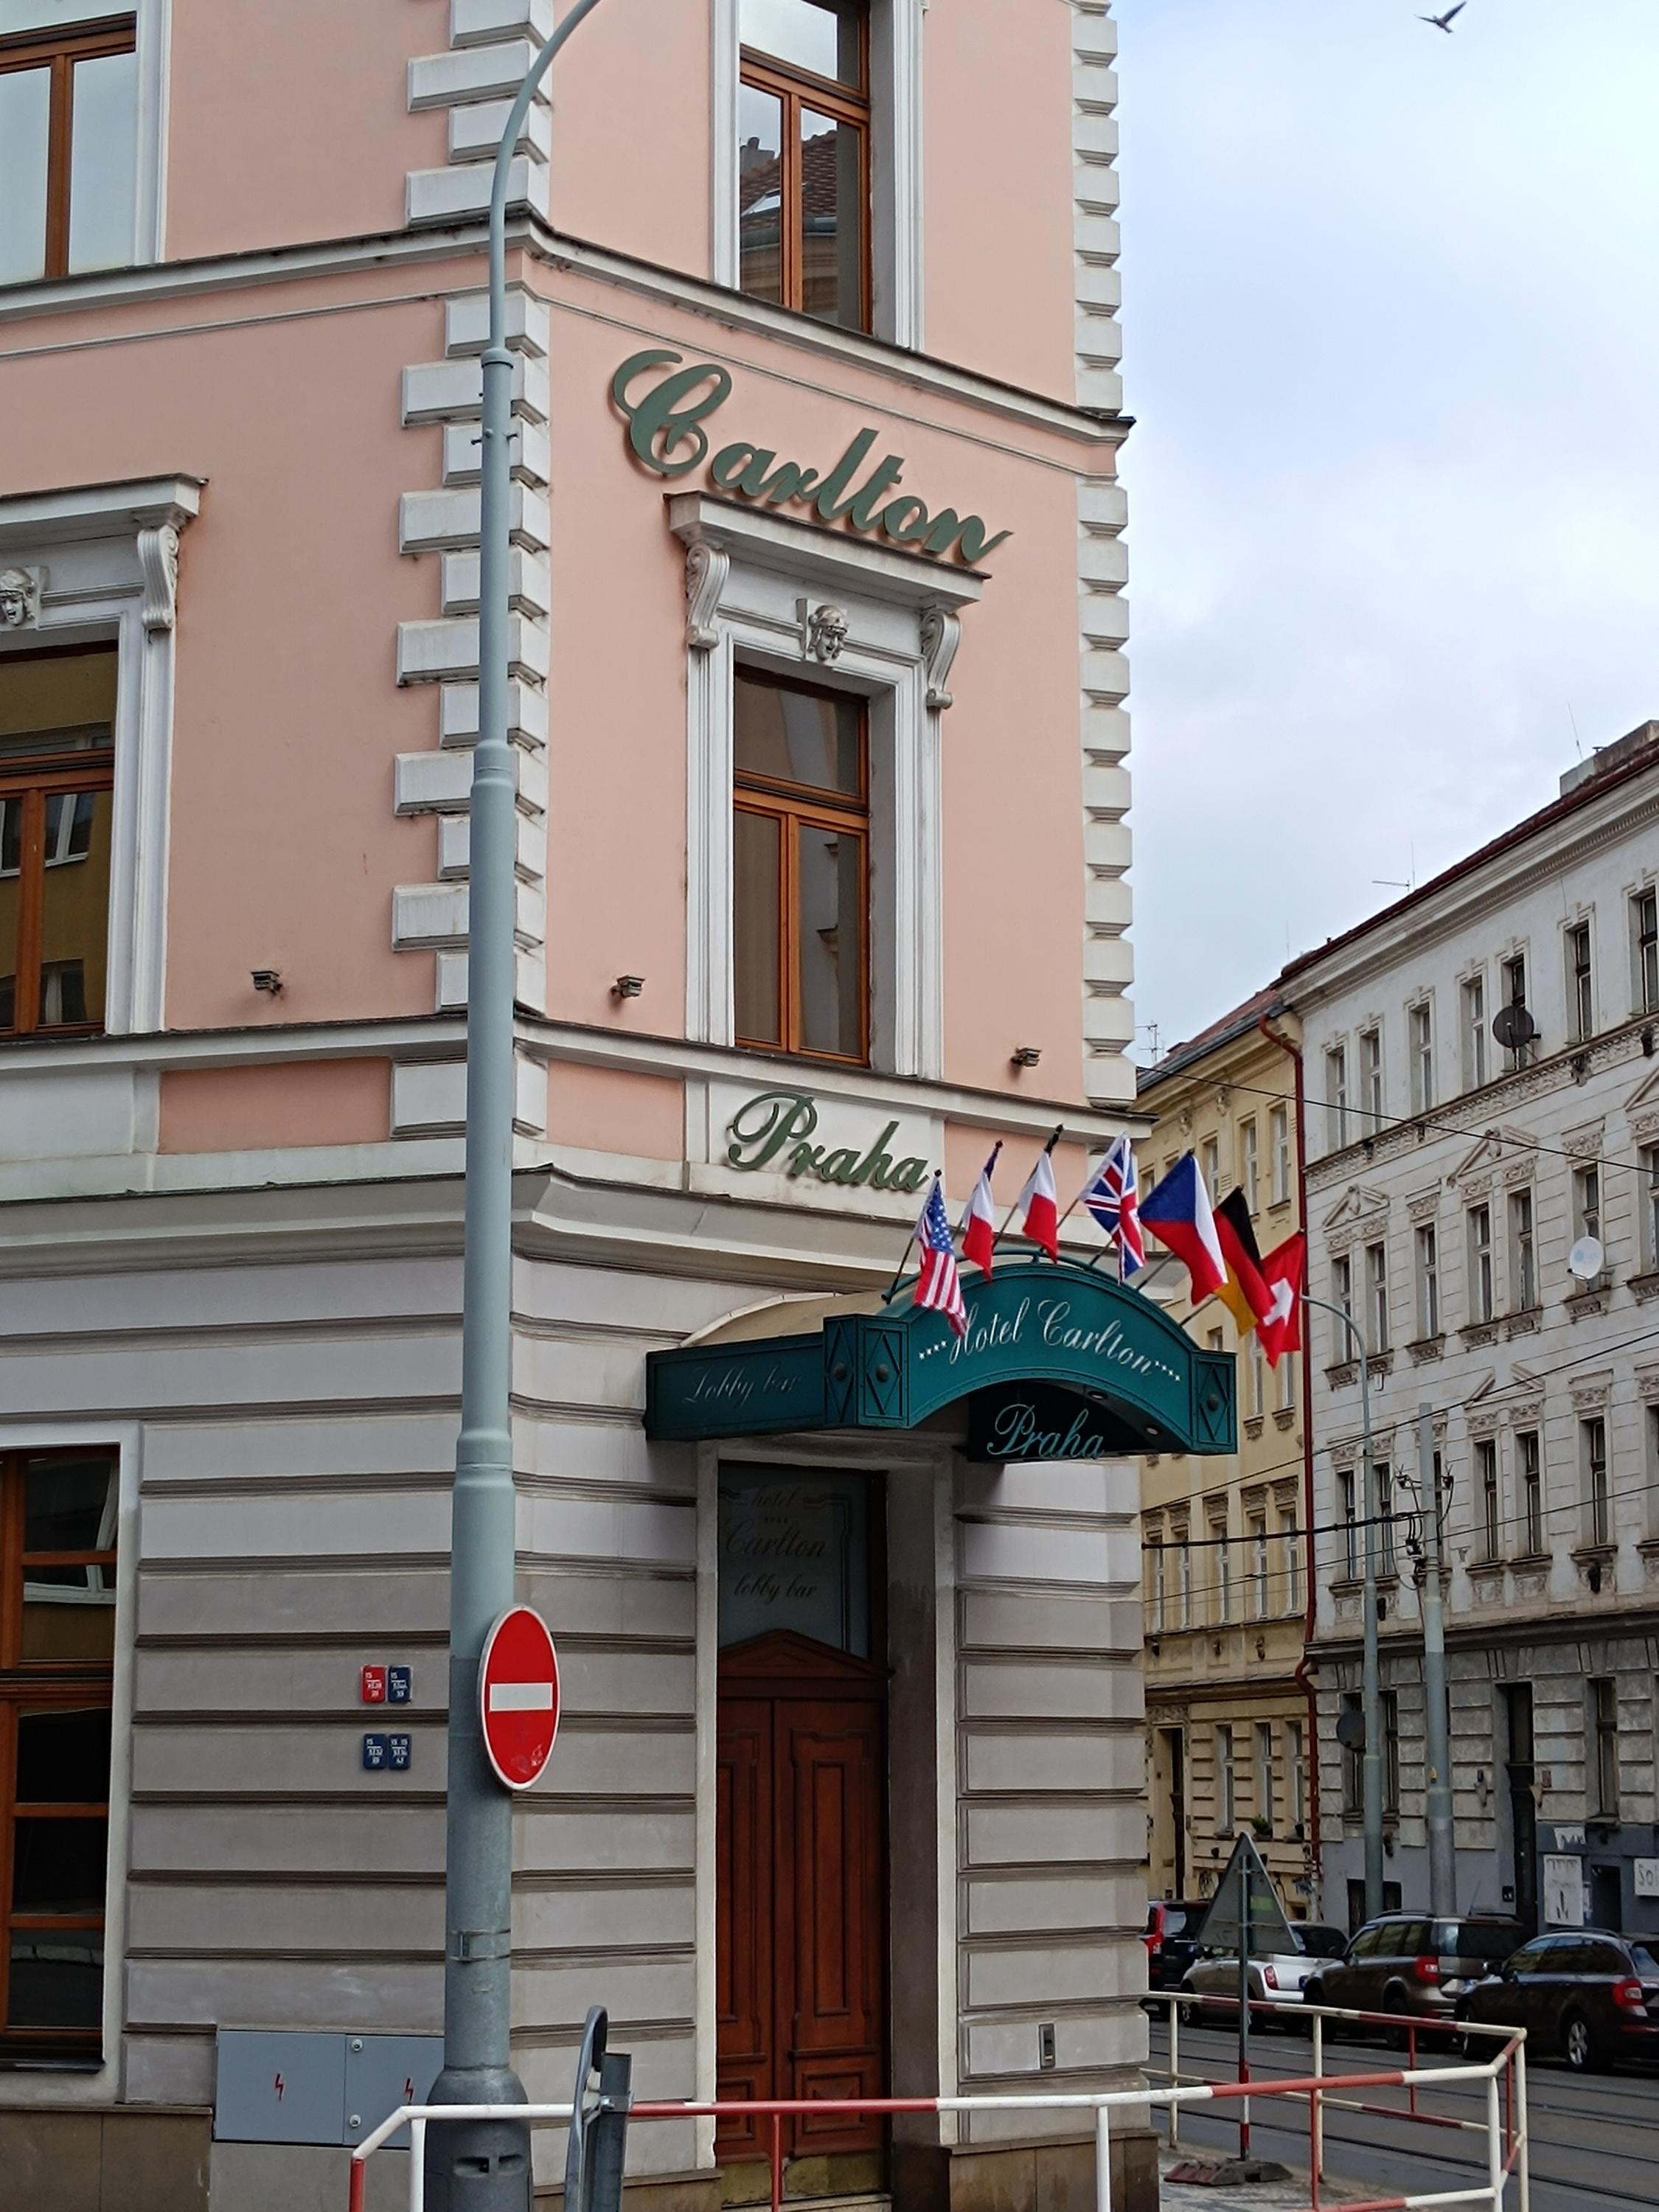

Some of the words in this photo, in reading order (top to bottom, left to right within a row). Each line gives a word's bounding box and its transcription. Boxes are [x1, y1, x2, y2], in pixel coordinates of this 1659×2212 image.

[613, 349, 1014, 563] Carlton
[727, 1091, 930, 1192] Praha
[949, 1297, 1030, 1365] Hotel
[1037, 1300, 1152, 1376] Carlton
[987, 1404, 1105, 1460] Praha
[724, 1516, 827, 1558] Carlton
